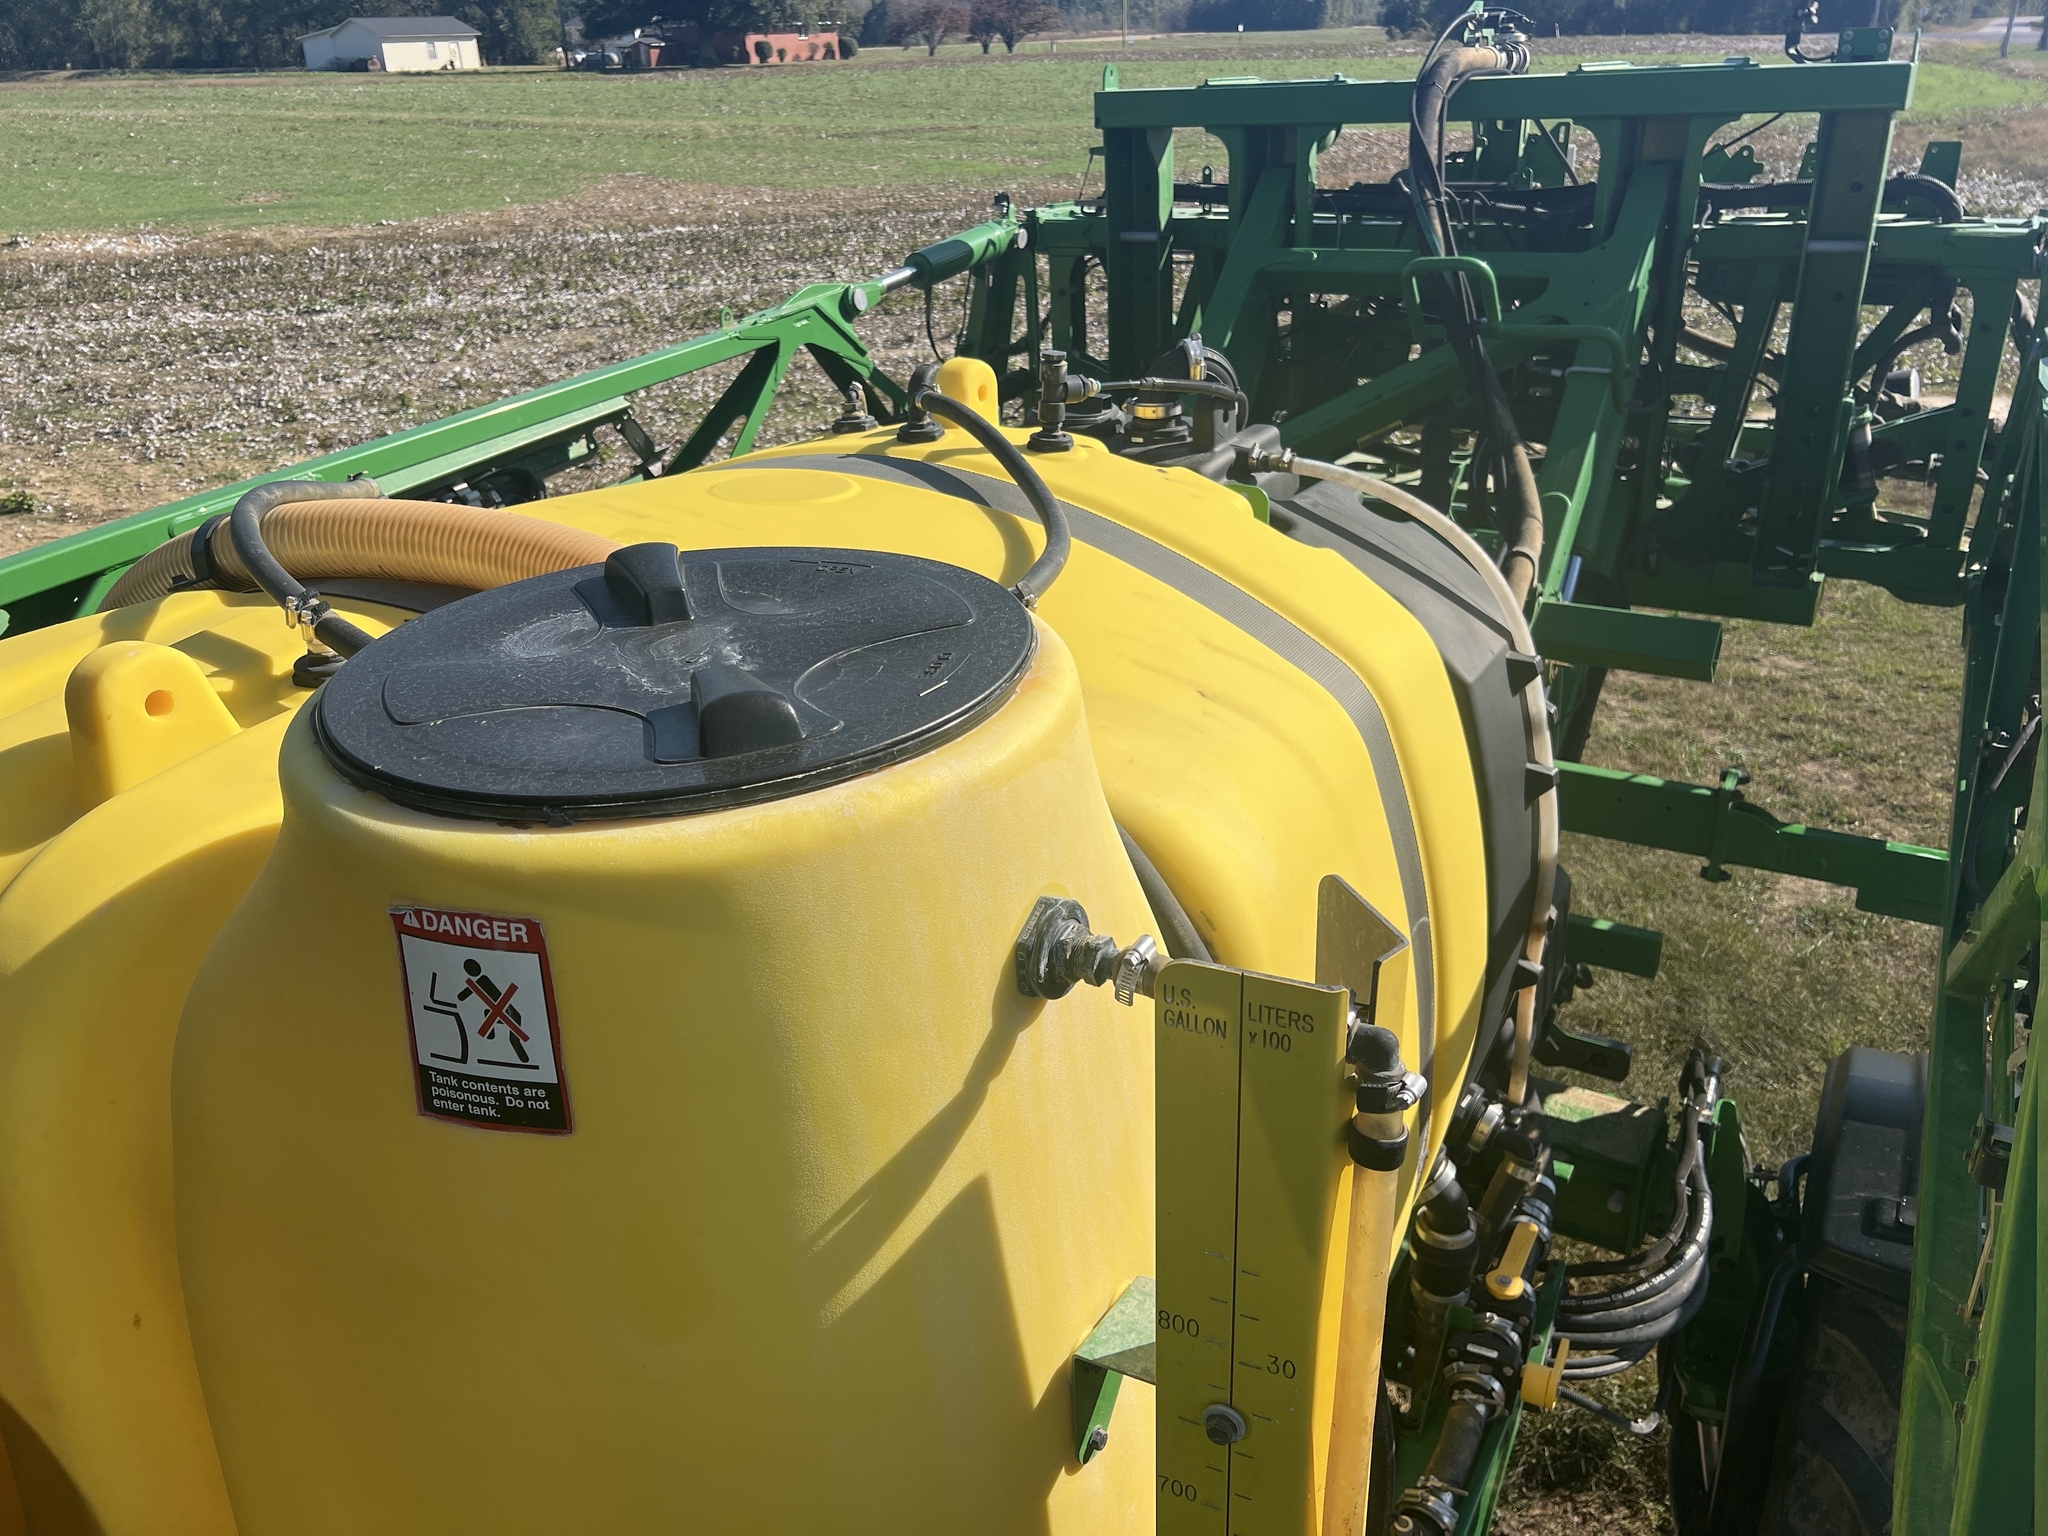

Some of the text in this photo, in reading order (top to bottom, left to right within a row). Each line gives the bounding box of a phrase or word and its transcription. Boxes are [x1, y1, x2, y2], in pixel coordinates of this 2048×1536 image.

[422, 911, 528, 943] DANGER
[1163, 984, 1196, 1009] U.S.
[1164, 1008, 1227, 1040] GALLON
[1248, 1001, 1315, 1034] LITERS
[429, 1071, 546, 1098] Tank contents are
[431, 1085, 550, 1110] poisonous. Do not
[433, 1098, 501, 1118] enter tank.
[1158, 1310, 1200, 1338] 800
[1266, 1354, 1296, 1380] 30
[1157, 1474, 1197, 1502] 700
